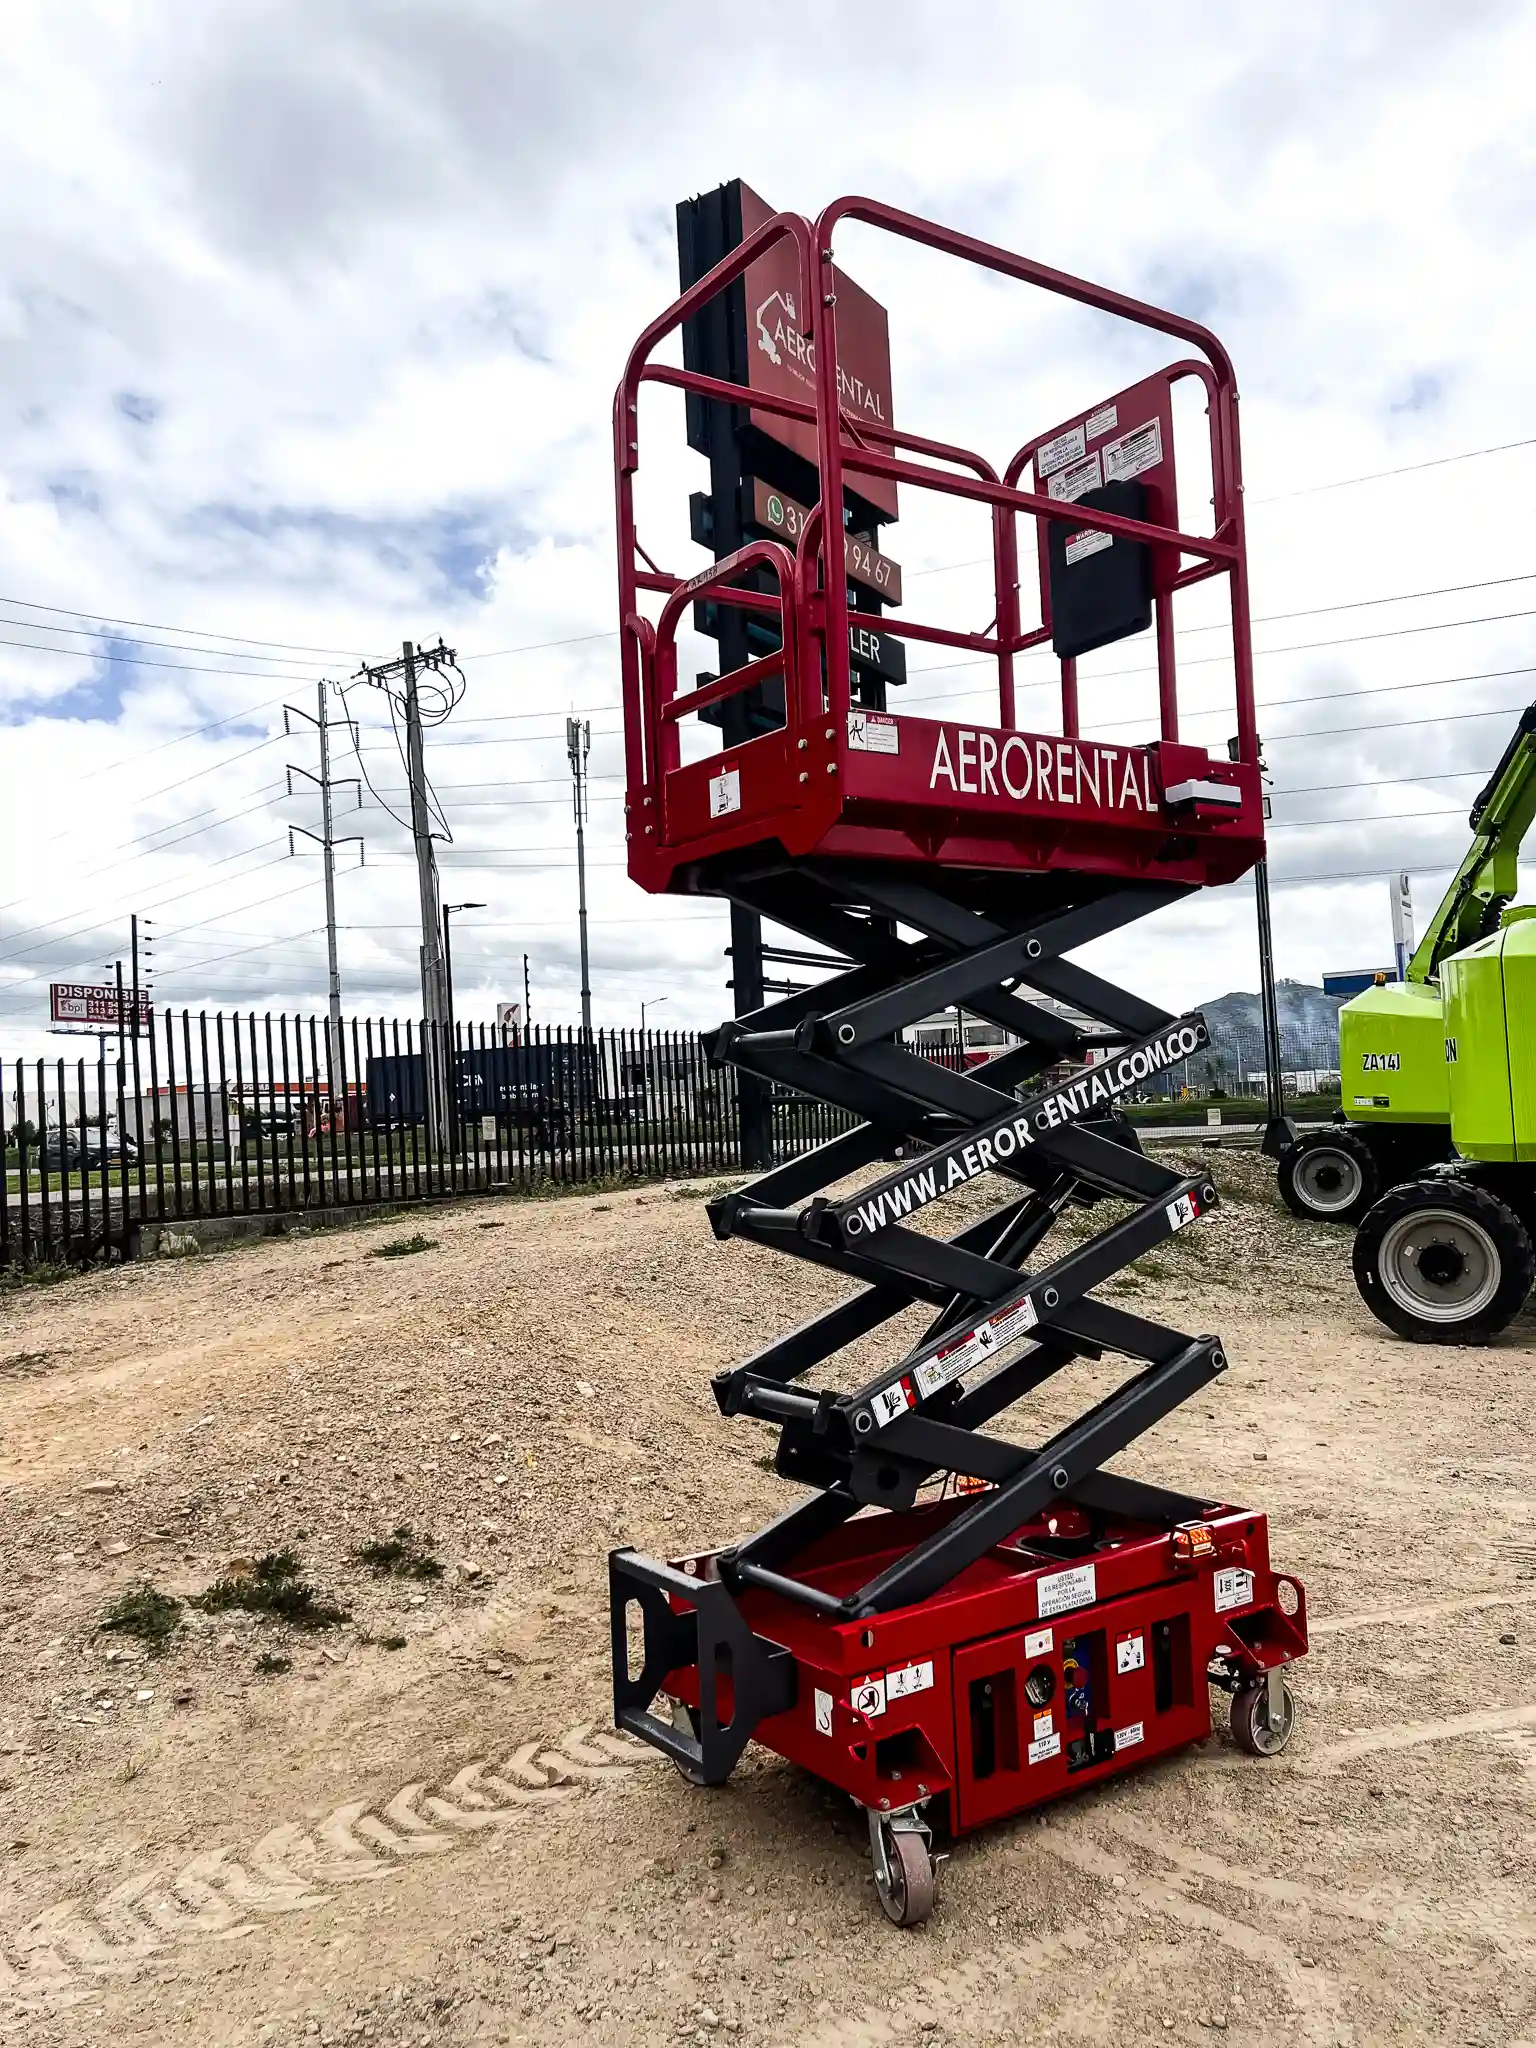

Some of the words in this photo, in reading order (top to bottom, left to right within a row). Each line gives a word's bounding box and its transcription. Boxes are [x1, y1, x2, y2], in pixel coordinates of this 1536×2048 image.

[853, 545, 871, 577] 94
[875, 559, 891, 586] 67
[929, 726, 1159, 813] AERORENTAL
[1362, 1053, 1400, 1071] ZA14J
[1052, 1575, 1087, 1590] RESPONSABLE
[1071, 1589, 1091, 1599] SEGURA
[1049, 1605, 1062, 1613] ESTA
